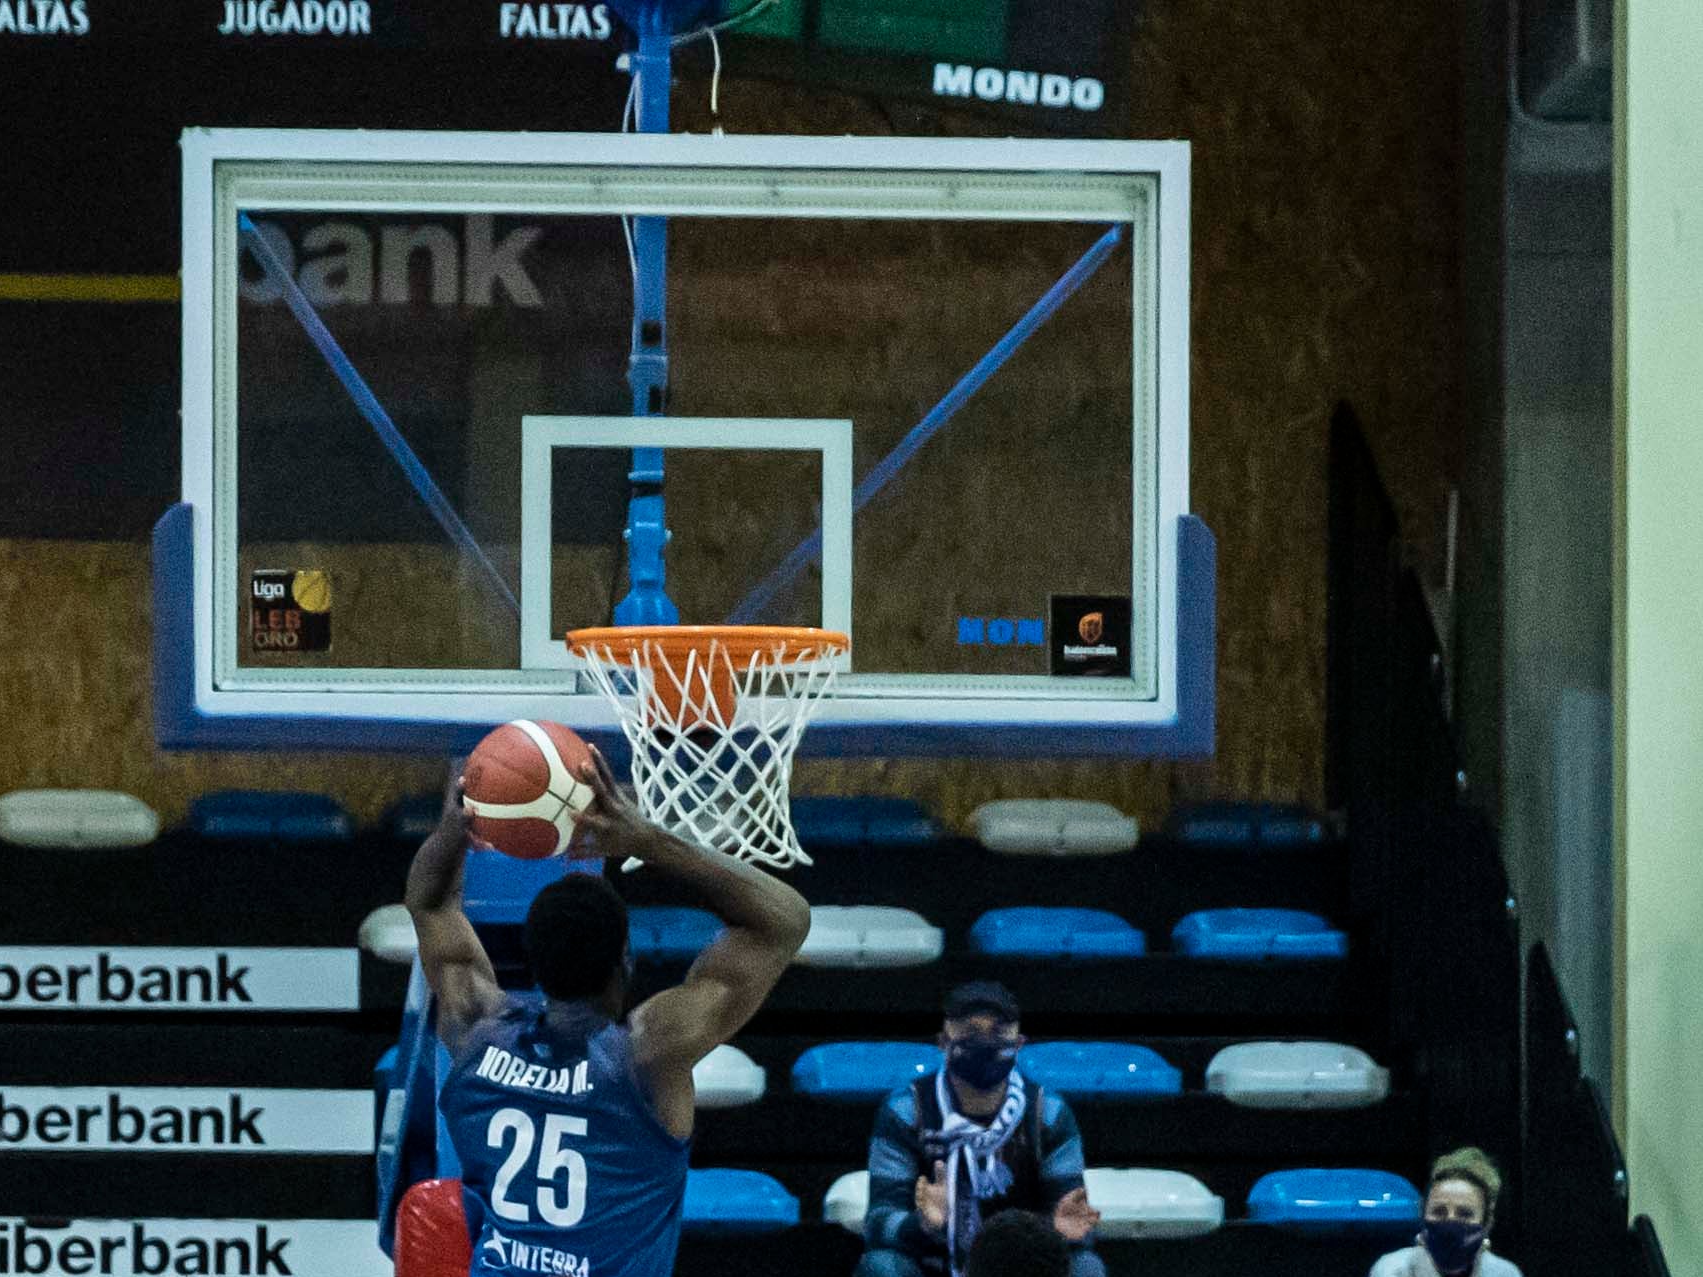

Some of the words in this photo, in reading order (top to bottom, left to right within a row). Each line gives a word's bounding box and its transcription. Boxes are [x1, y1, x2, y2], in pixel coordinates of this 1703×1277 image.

[218, 0, 371, 35] JUGADOR
[499, 4, 611, 40] FALTAS
[932, 62, 1105, 110] MONDO
[957, 616, 1044, 645] MON
[487, 1107, 588, 1227] 25
